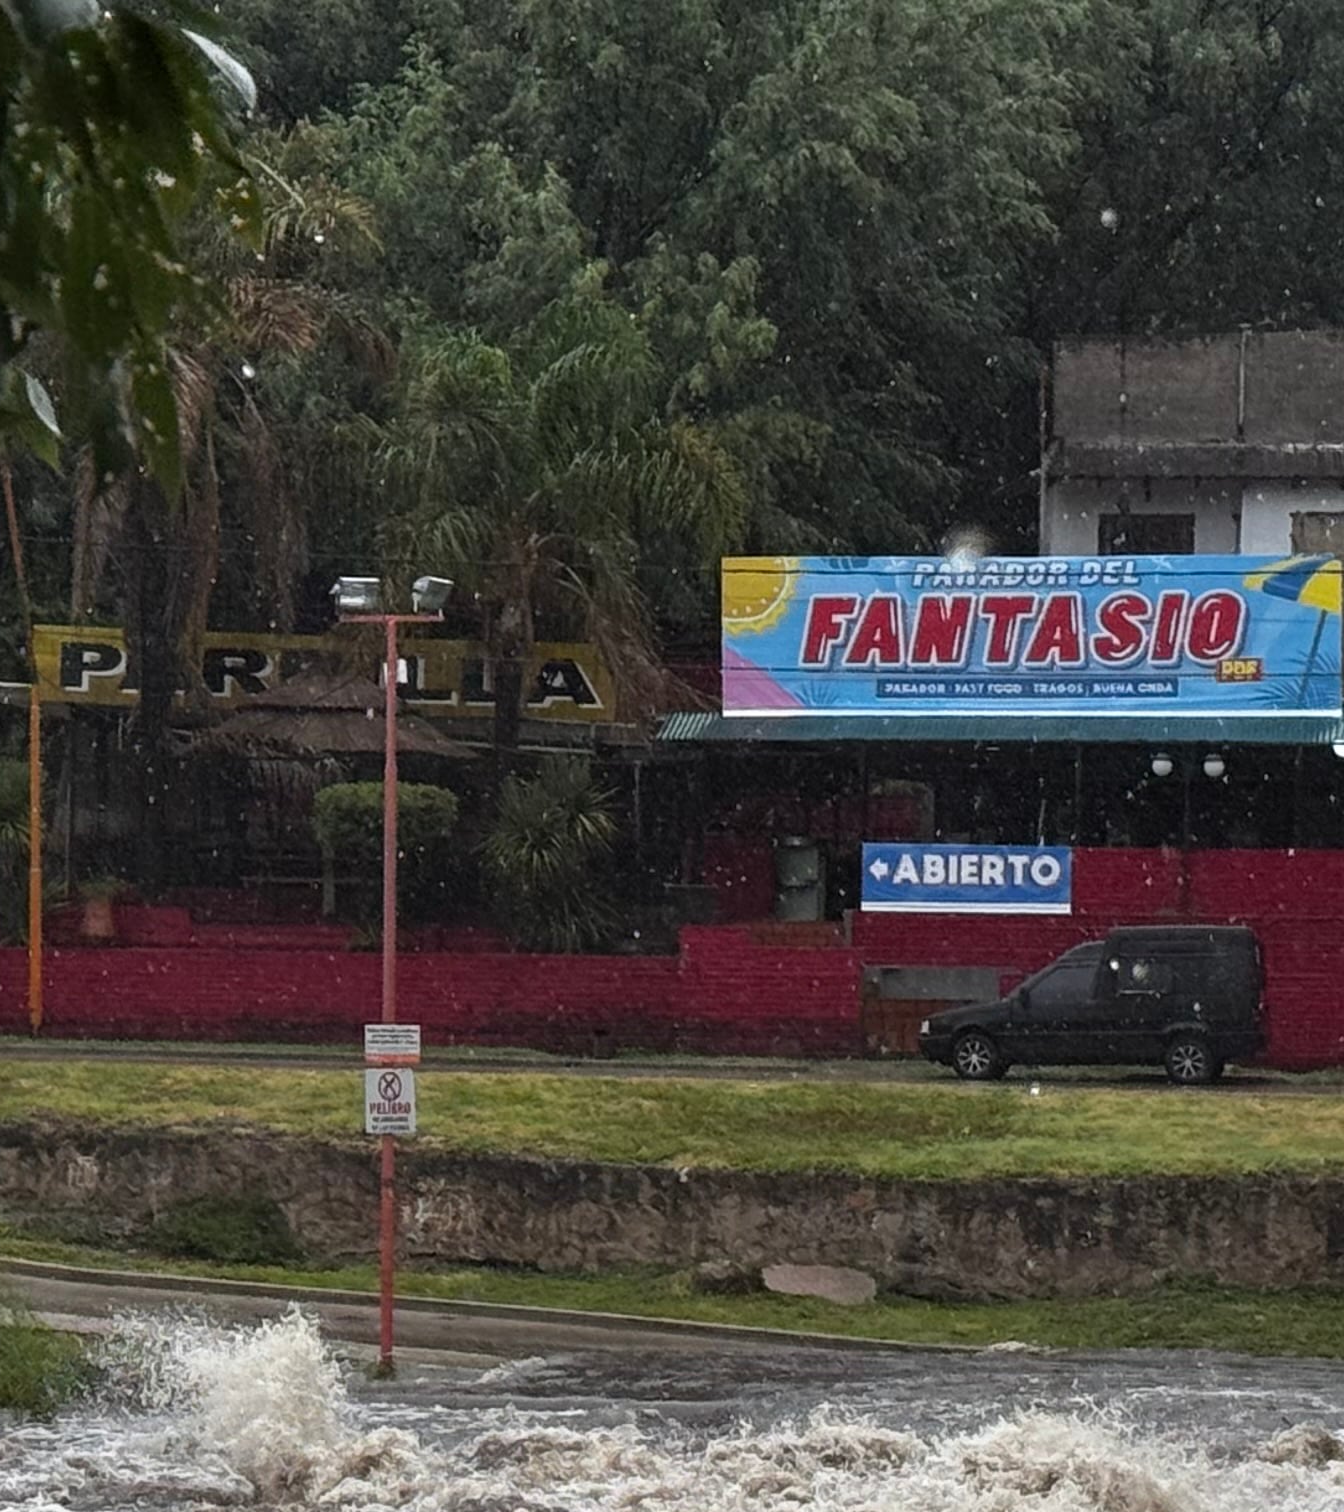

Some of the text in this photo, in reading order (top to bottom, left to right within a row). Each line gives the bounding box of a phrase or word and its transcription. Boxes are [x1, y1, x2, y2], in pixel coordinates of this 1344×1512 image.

[911, 560, 1140, 587] PARADOR DEL
[801, 592, 1246, 668] FANTASIO
[893, 853, 1062, 886] ABIERTO
